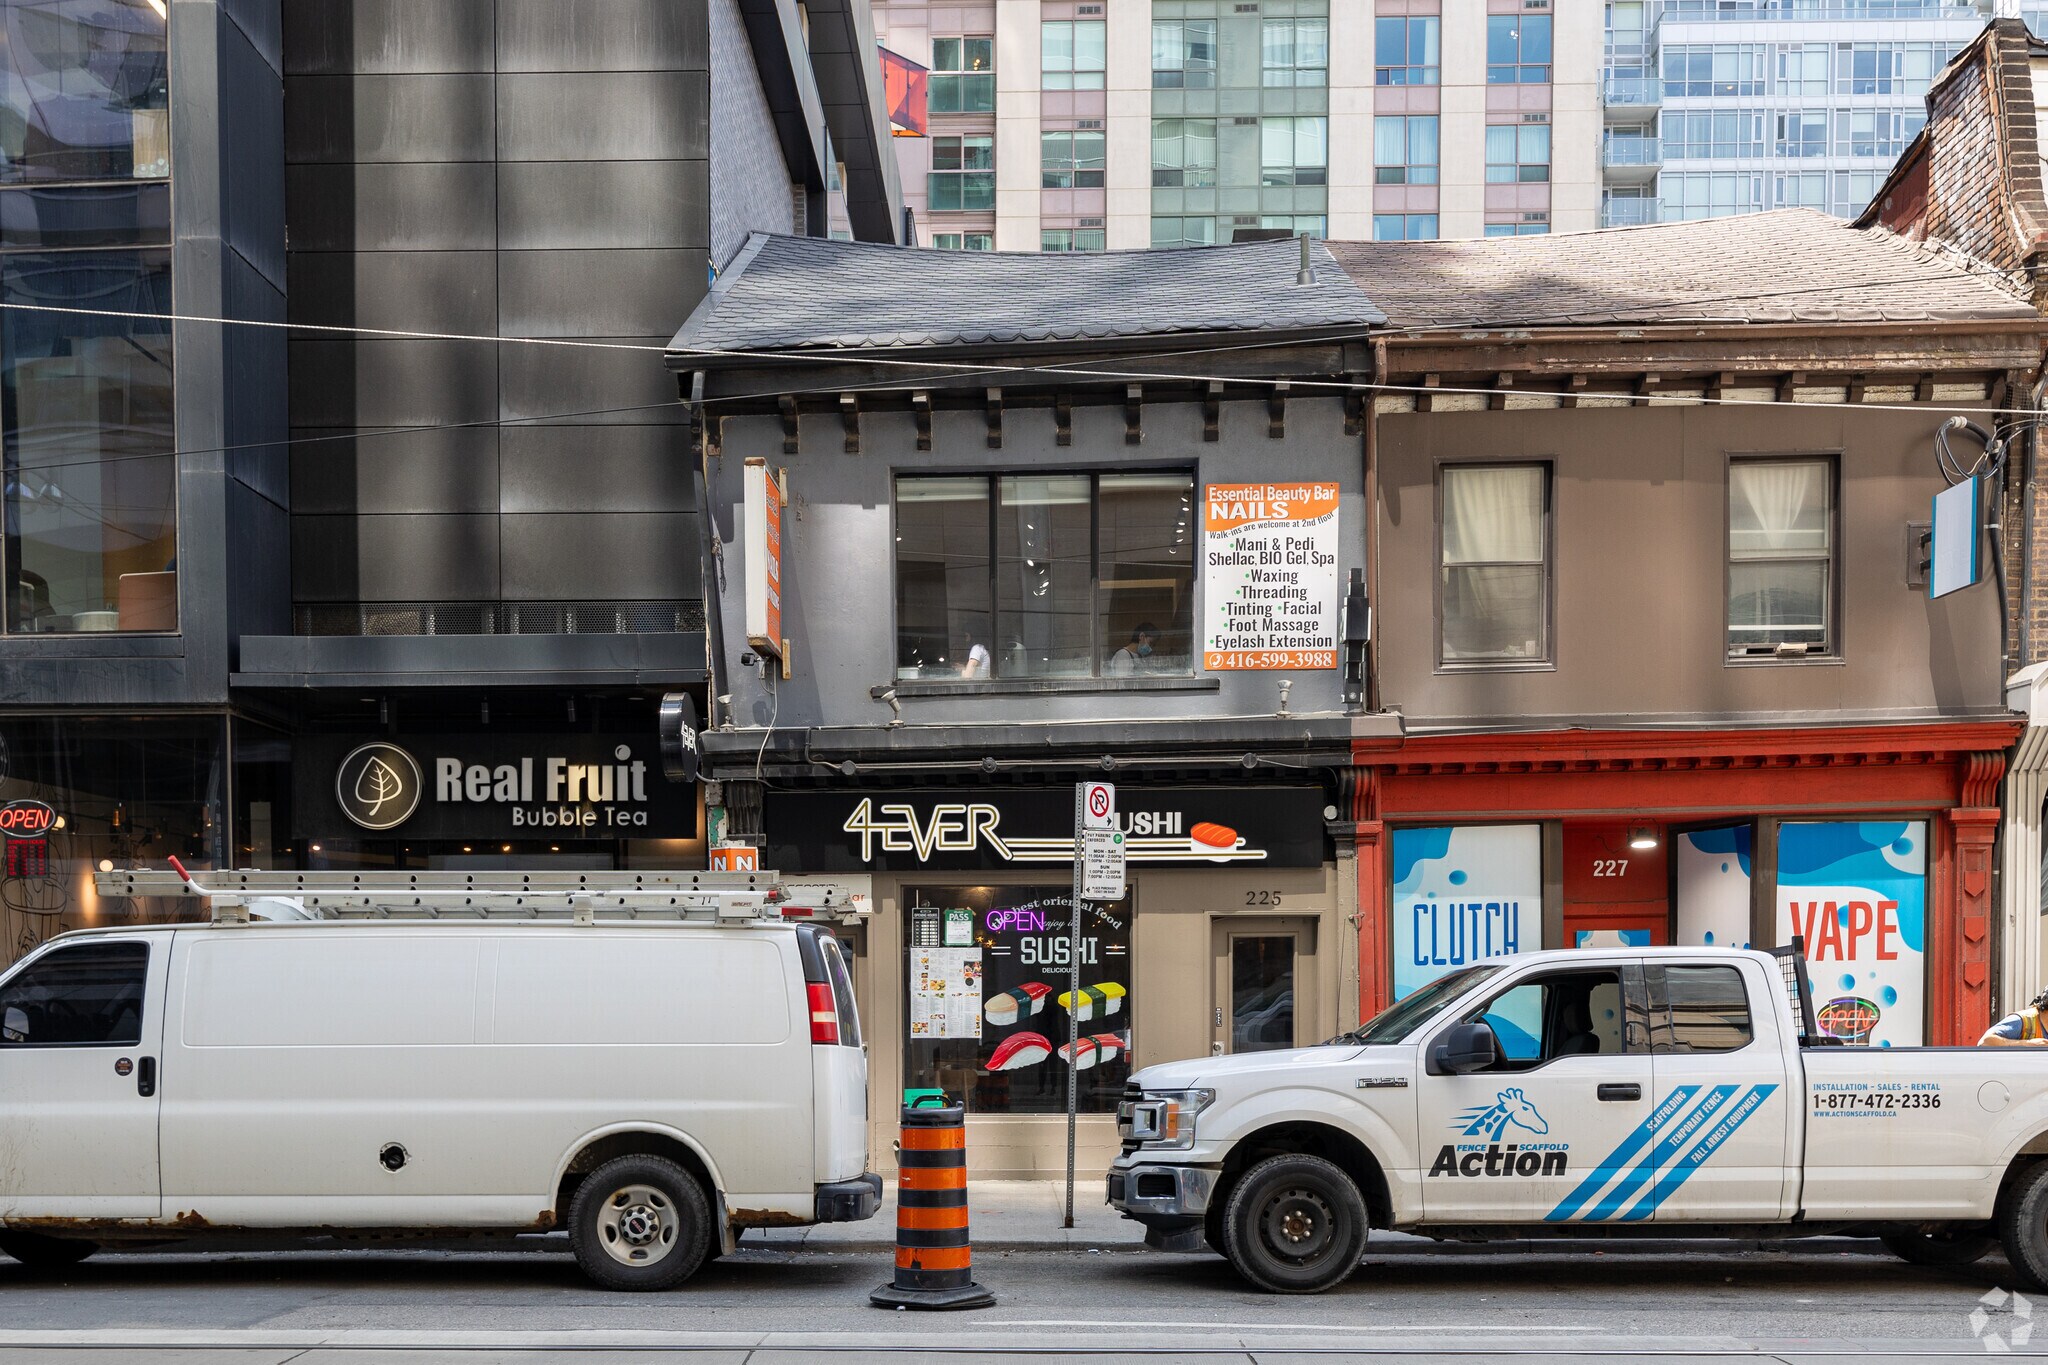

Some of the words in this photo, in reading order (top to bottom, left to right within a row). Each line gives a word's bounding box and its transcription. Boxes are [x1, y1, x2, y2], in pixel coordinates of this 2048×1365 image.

[1209, 486, 1264, 502] Essential
[1267, 486, 1311, 504] Beauty
[1314, 485, 1335, 501] Bar
[1210, 502, 1289, 520] NAILS
[1209, 529, 1242, 540] Walk-ins
[1244, 524, 1256, 532] are
[1258, 520, 1290, 530] welcome
[1292, 520, 1300, 528] at
[1302, 518, 1316, 528] 2nd
[1318, 512, 1334, 524] floor
[1235, 537, 1267, 551] Mani
[1272, 538, 1280, 551] &
[1286, 536, 1314, 550] Pedi
[1260, 552, 1282, 565] BIO
[1312, 552, 1334, 570] Spa
[1251, 569, 1298, 585] Waxing
[1241, 585, 1308, 601] Threading
[1226, 602, 1272, 618] Tinting
[1283, 602, 1322, 615] Facial
[1229, 618, 1258, 632] Foot
[1262, 618, 1319, 634] Massage
[1215, 634, 1264, 650] Eyelash
[1270, 634, 1332, 648] Extension
[1226, 652, 1332, 668] 416-599-3988
[436, 757, 533, 802] Real
[547, 744, 648, 802] Fruit
[0, 808, 50, 828] OPEN
[512, 806, 597, 826] Bubble
[605, 806, 648, 826] Tea
[842, 796, 1014, 862] 4EVER
[1114, 810, 1182, 836] USHI
[1594, 860, 1628, 877] 227
[1246, 891, 1282, 906] 225
[986, 910, 1045, 931] OPEN
[1013, 898, 1040, 916] best
[1095, 908, 1122, 930] food
[1042, 919, 1065, 931] enjoy
[1414, 902, 1518, 966] CLUTCH
[1789, 900, 1898, 962] VAPE
[1820, 1008, 1874, 1029] OPEN
[1646, 1090, 1687, 1132] SCAFFOLDING
[1814, 1094, 1941, 1109] 1-877-472-2336
[1668, 1110, 1706, 1147] TEMPORARY
[1702, 1090, 1724, 1114] FENCE
[1690, 1146, 1709, 1164] FALL
[1705, 1123, 1730, 1150] ARREST
[1727, 1090, 1761, 1128] EQUIPMENT
[1428, 1144, 1568, 1178] Action
